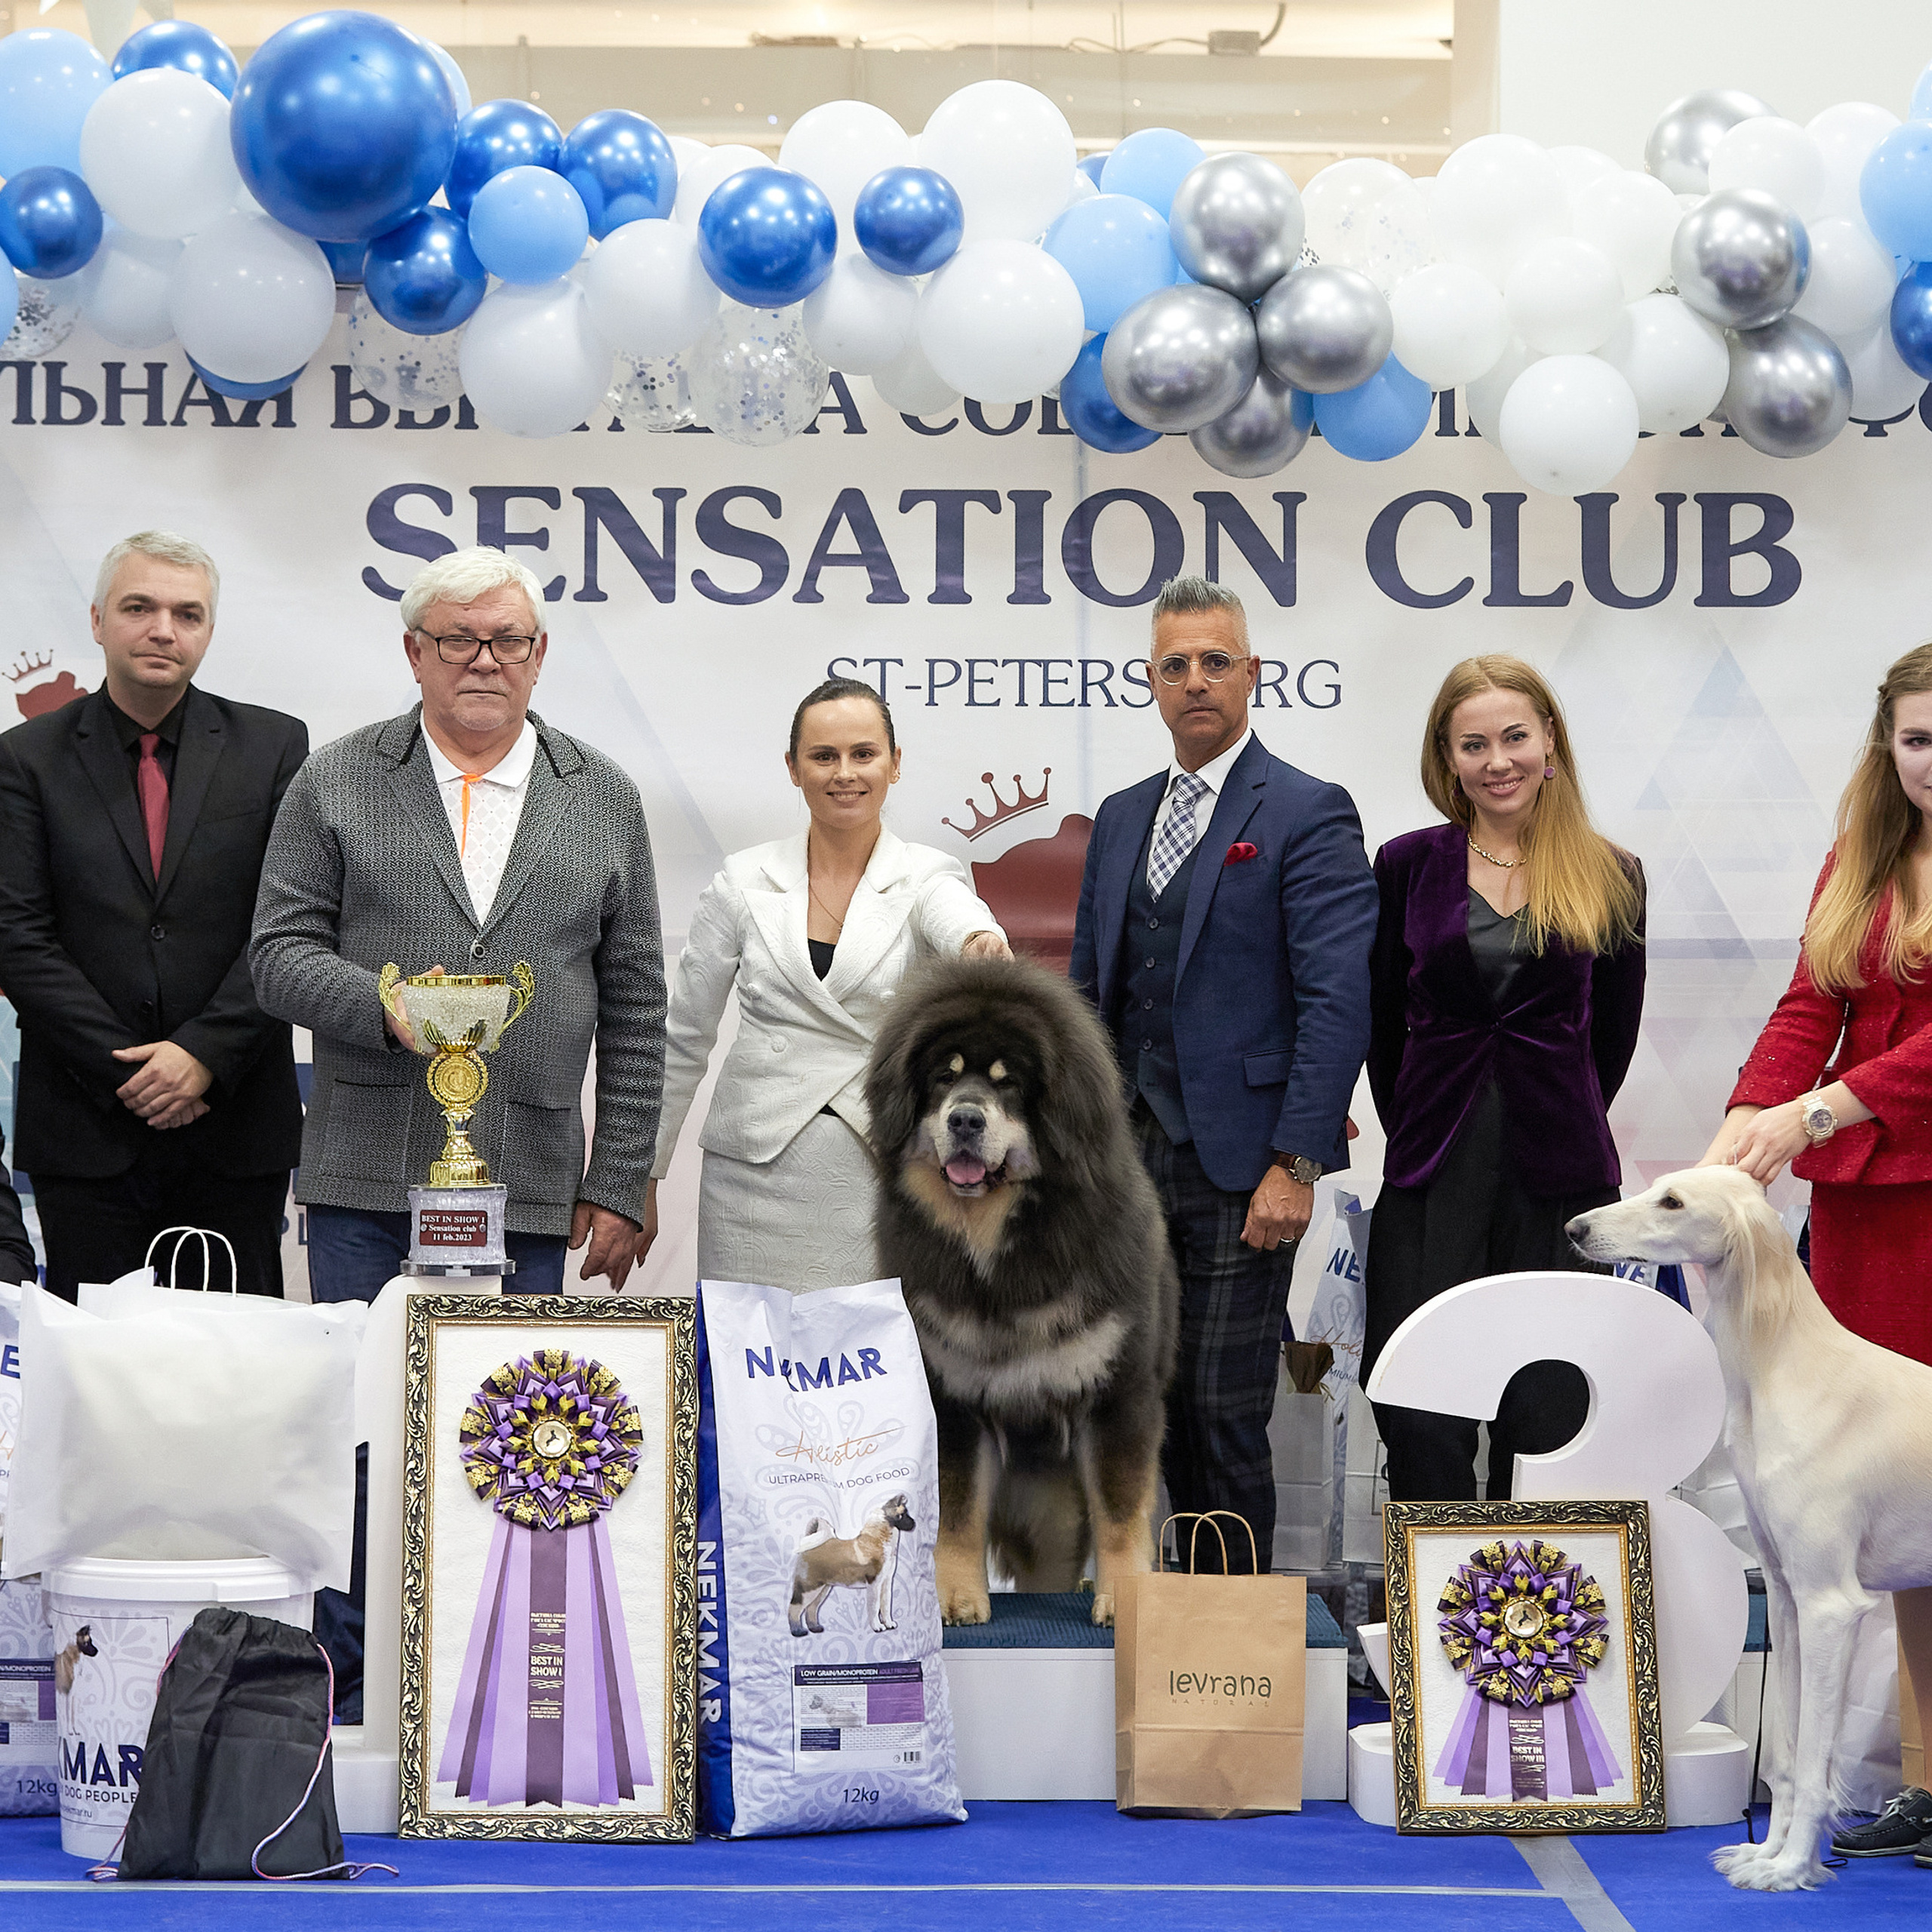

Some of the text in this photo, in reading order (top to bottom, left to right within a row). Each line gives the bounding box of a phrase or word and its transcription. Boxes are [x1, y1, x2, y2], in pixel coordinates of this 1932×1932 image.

[361, 483, 1804, 610] SENSATION CLUB
[826, 657, 1343, 709] ST-PETERSRG
[428, 1224, 461, 1232] Sensation
[847, 1476, 874, 1490] DOG
[875, 1467, 911, 1482] FOOD
[697, 1540, 722, 1725] NEKMAR
[531, 1656, 563, 1666] BEST IN
[531, 1667, 557, 1676] SHOW
[1170, 1670, 1272, 1698] levrana
[16, 1779, 57, 1797] 12kg
[65, 1785, 82, 1799] DOG
[843, 1786, 879, 1804] 12kg
